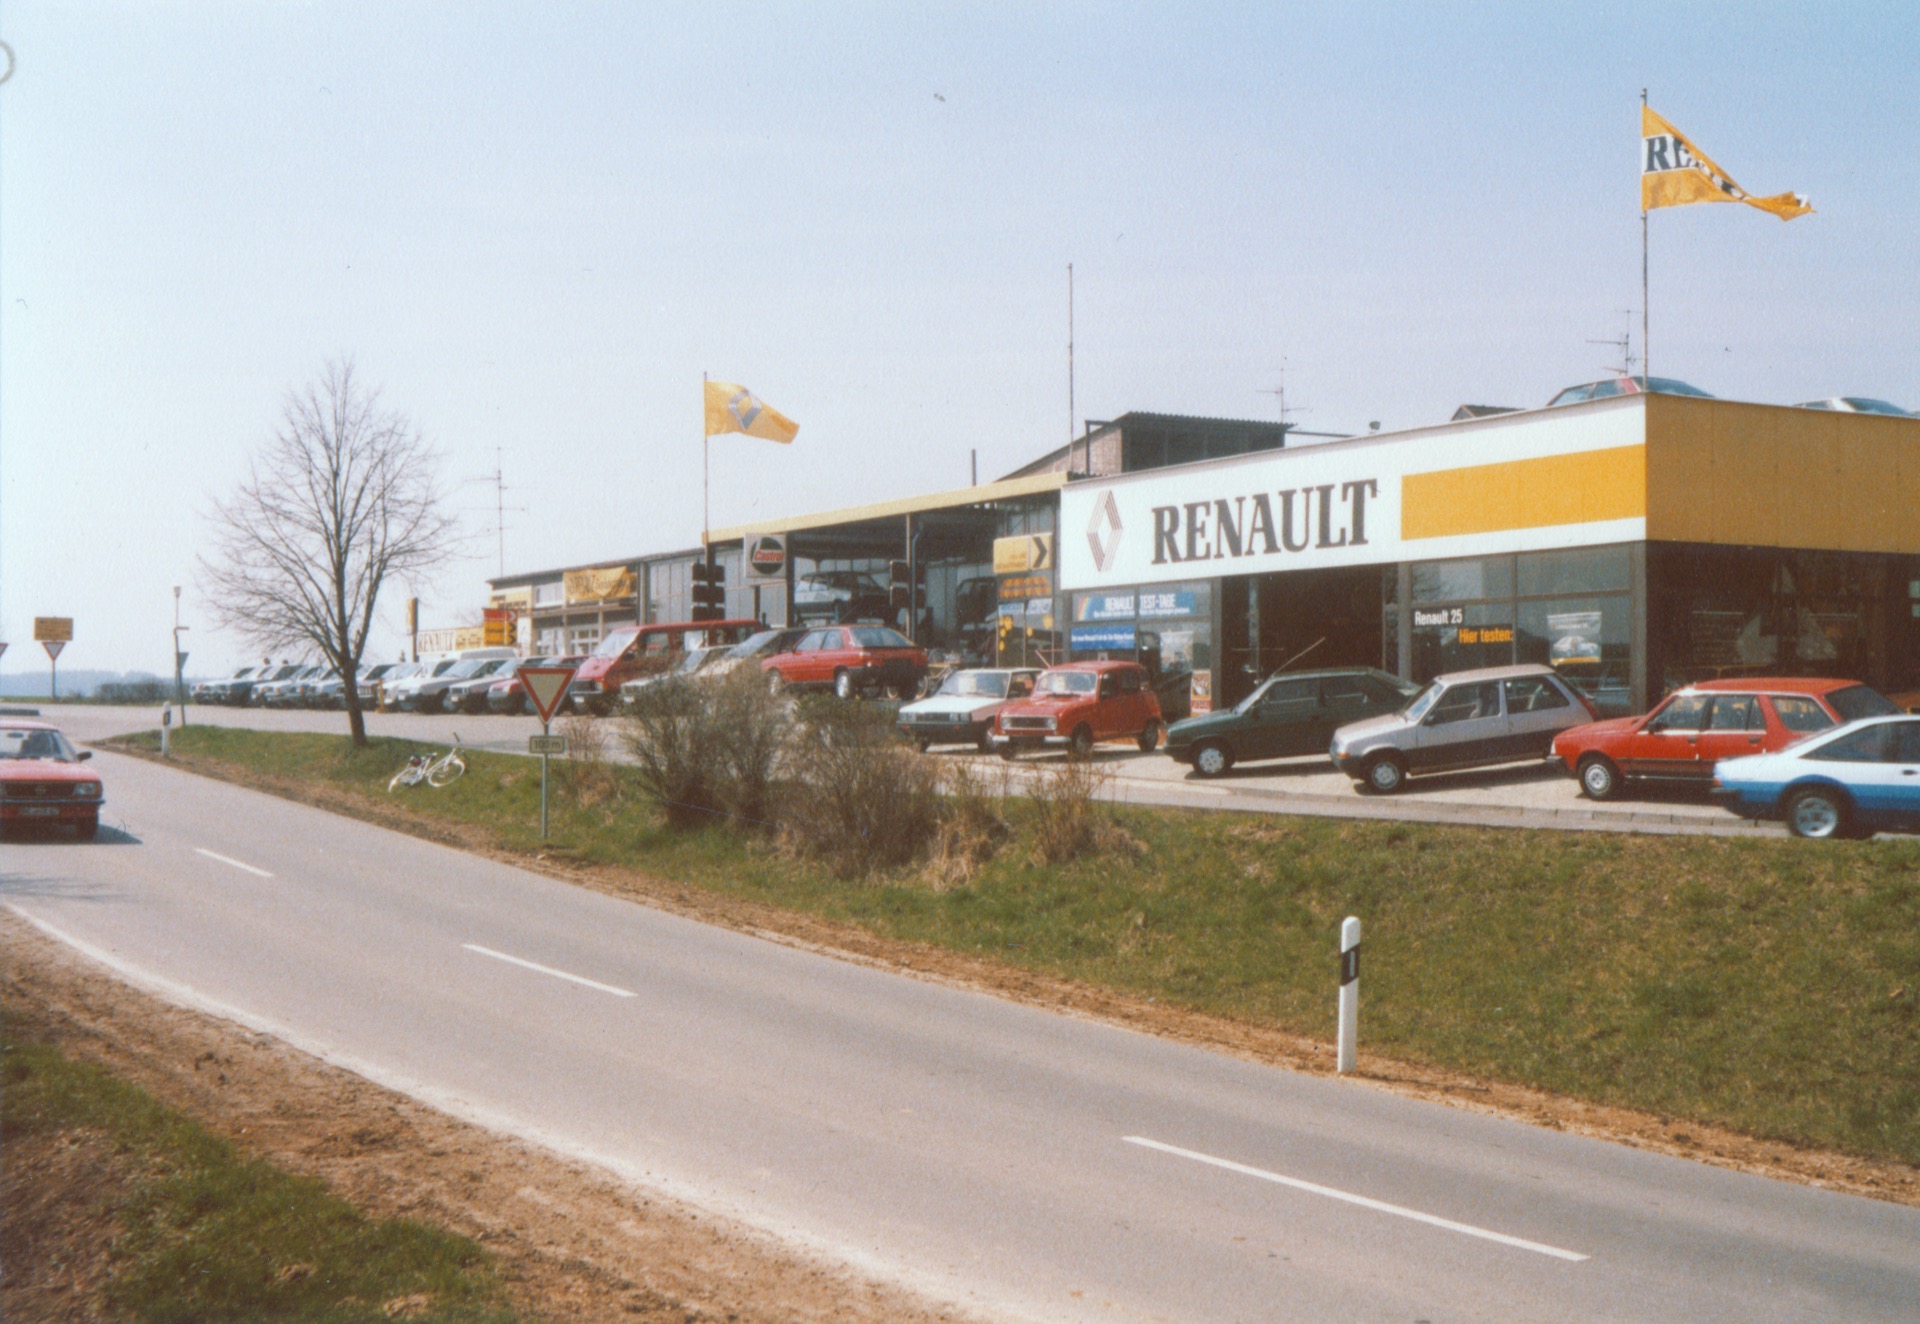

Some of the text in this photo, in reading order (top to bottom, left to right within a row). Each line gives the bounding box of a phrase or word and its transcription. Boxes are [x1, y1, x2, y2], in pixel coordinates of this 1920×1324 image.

[1151, 478, 1377, 565] RENAULT
[1105, 594, 1176, 611] RENAULT TEST-TAGE
[1414, 608, 1463, 626] Renault 25
[1458, 627, 1478, 644] Hier
[534, 740, 550, 749] 100
